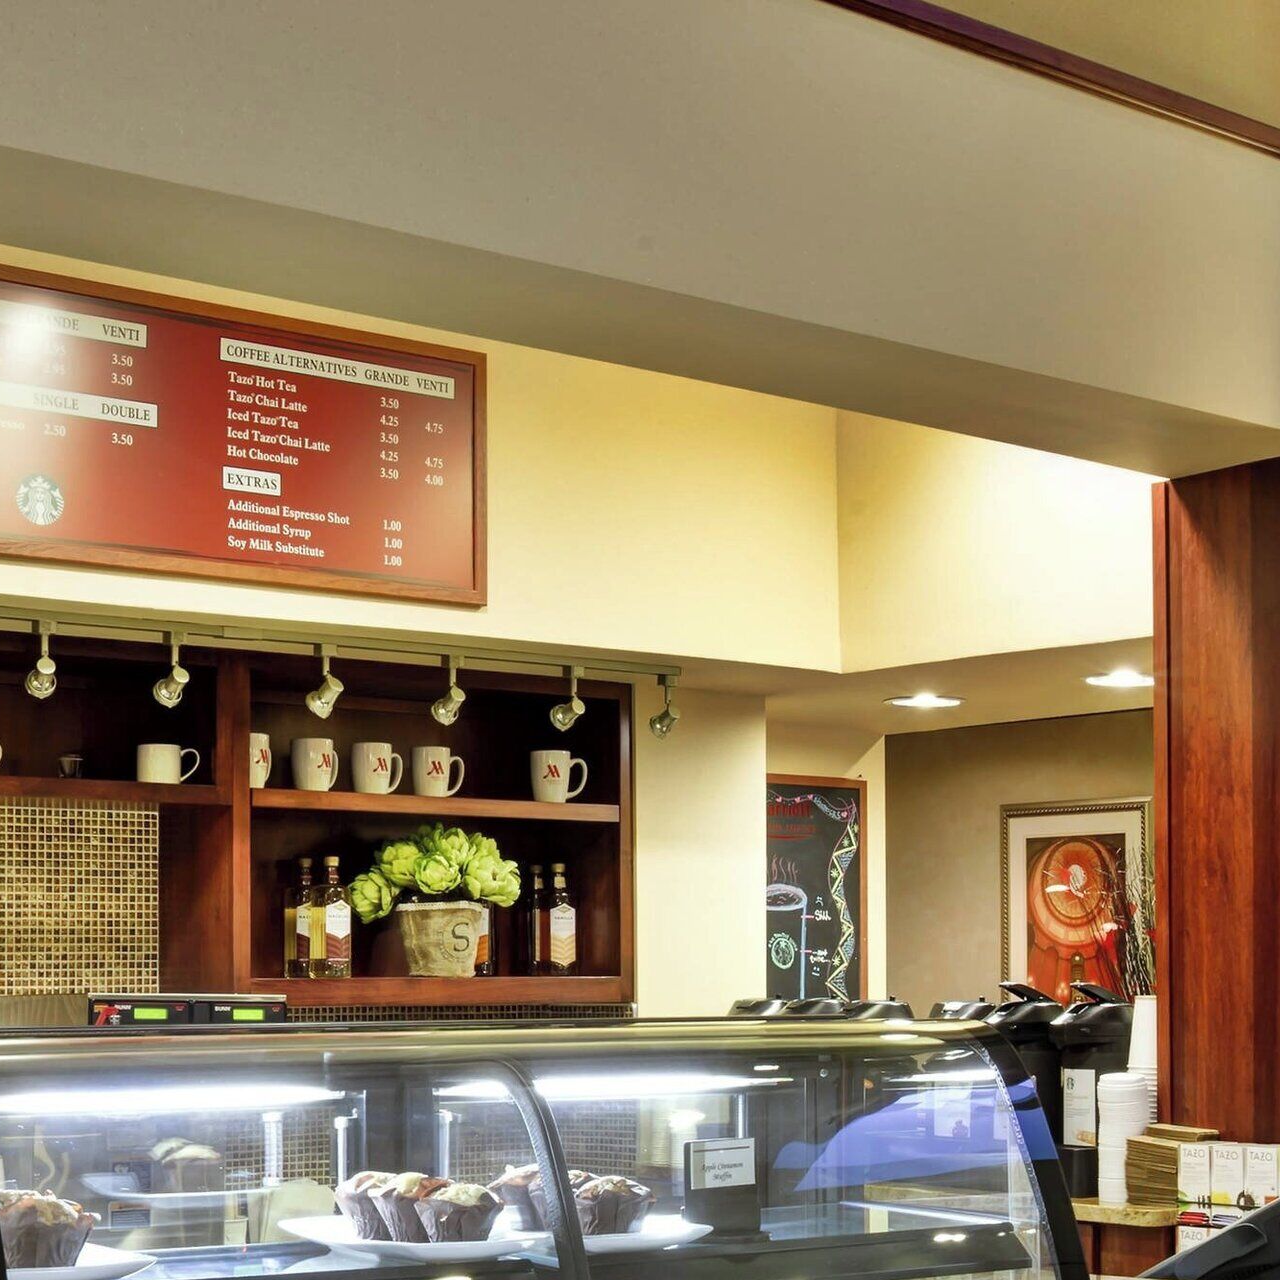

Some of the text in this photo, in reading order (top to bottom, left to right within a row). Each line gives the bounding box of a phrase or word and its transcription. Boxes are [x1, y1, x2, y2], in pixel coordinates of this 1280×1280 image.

[102, 324, 140, 341] VENTI
[112, 354, 133, 367] 3.50
[226, 345, 449, 394] COFFEE ALTERNATIVES GRANDE VENTI
[112, 373, 132, 386] 3.50
[256, 376, 274, 389] Hot
[277, 379, 297, 393] Tea
[380, 397, 399, 410] 3.50
[33, 392, 79, 411] SINGLE
[101, 403, 150, 421] DOUBLE
[256, 394, 279, 408] Chai
[281, 398, 308, 412] Latte
[380, 415, 399, 427] 4.25
[425, 422, 443, 434] 4.75
[44, 424, 66, 437] 2.50
[112, 432, 133, 446] 3.50
[228, 408, 249, 422] Iced
[280, 416, 299, 430] Tea
[380, 432, 399, 445] 3.50
[228, 427, 249, 440] Iced
[279, 434, 302, 448] Chai
[304, 438, 330, 452] Latte
[380, 450, 399, 462] 4.25
[425, 457, 443, 469] 4.75
[227, 445, 443, 486] Hot Chocolate 3.50 4.00
[227, 473, 277, 490] EXTRAS
[228, 499, 402, 532] Additional Espresso Shot 1.00
[228, 518, 402, 549] Additional Syrup 1.00
[228, 536, 402, 567] Soy Milk Substitute 1.00
